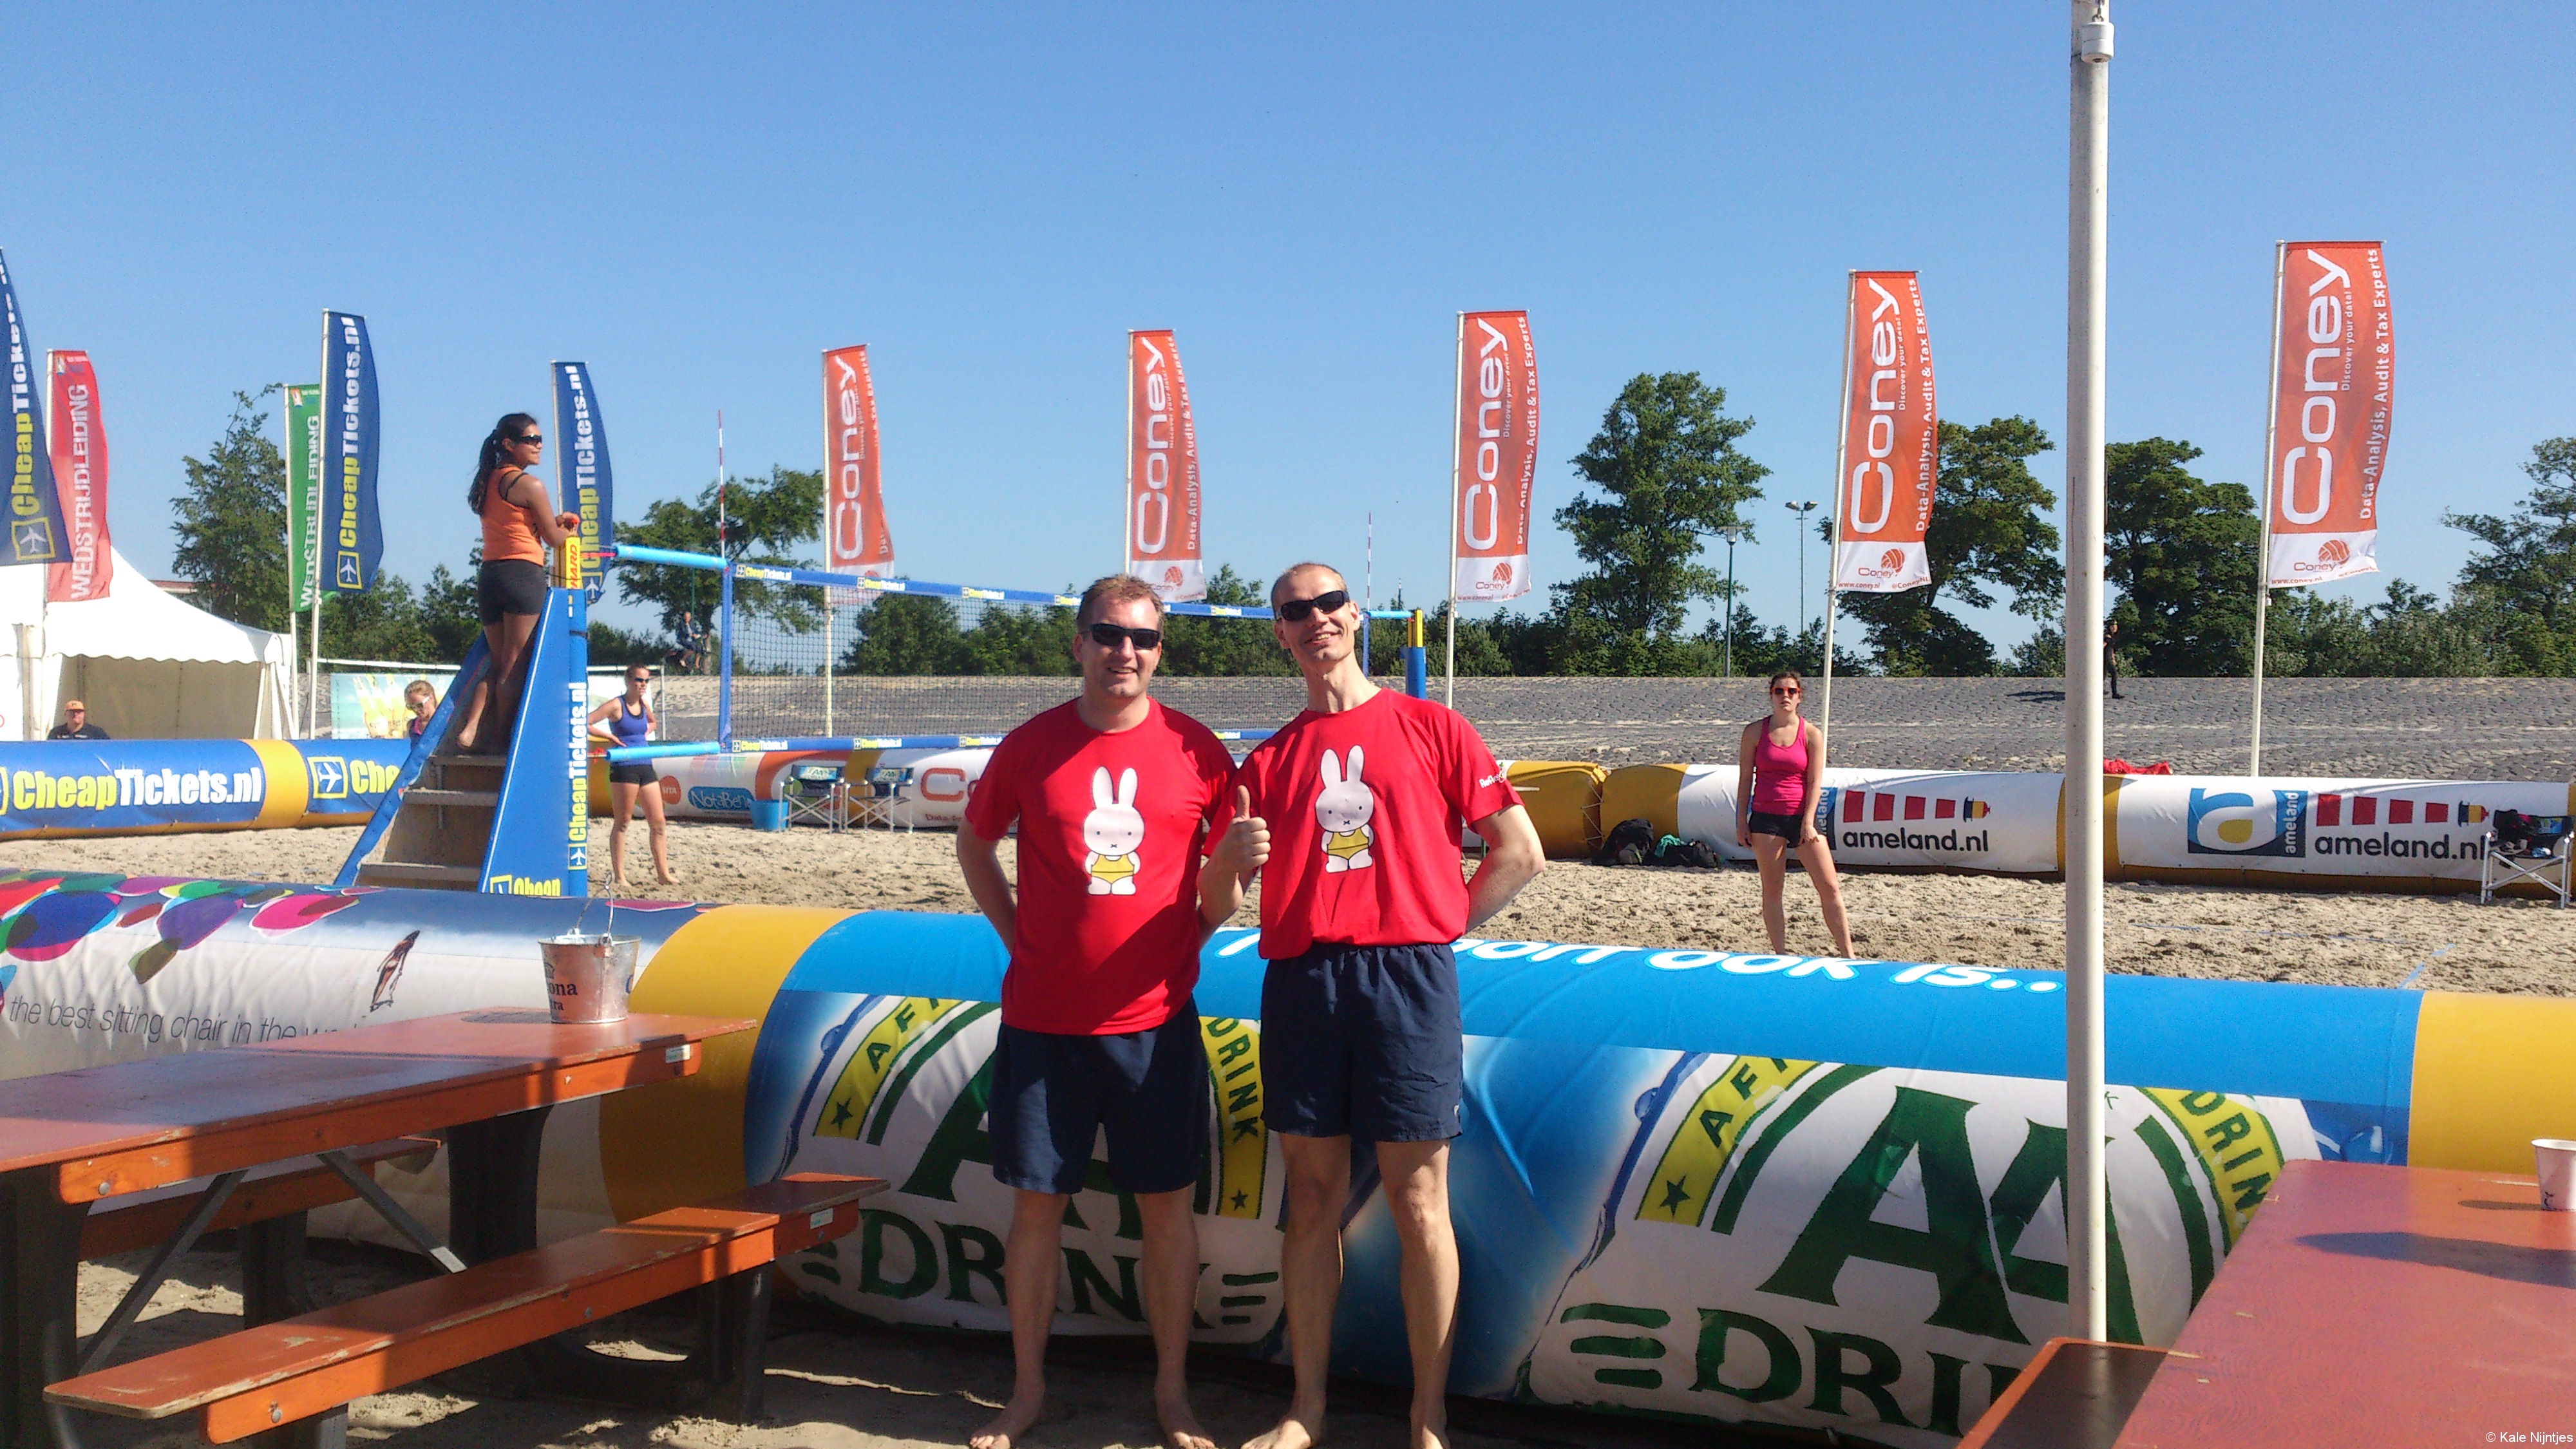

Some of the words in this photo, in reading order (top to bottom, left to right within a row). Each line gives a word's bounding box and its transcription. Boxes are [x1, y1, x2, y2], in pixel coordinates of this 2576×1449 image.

[2367, 249, 2387, 308] Experts
[1908, 279, 1926, 334] Experts
[2344, 291, 2353, 317] data!
[2376, 312, 2389, 339] Tax
[1517, 316, 1534, 367] Experts
[1920, 338, 1929, 363] Tax
[2345, 321, 2355, 344] your
[2376, 343, 2389, 355] &
[1897, 344, 1906, 367] your
[1922, 366, 1931, 377] &
[2341, 347, 2353, 391] Discover
[1526, 370, 1537, 394] Tax
[1527, 397, 1537, 406] &
[1922, 381, 1933, 422] Audit
[2282, 249, 2351, 524] Coney
[2373, 358, 2389, 402] Audit
[1502, 401, 1512, 438] Discover
[1526, 409, 1537, 446] Audit
[1850, 278, 1900, 533] Coney
[338, 317, 361, 547] CheapTickets.nl
[1138, 337, 1170, 554] Coney
[1464, 317, 1508, 551] Coney
[565, 365, 600, 569] CheapTickets.nl
[835, 354, 863, 559] Coney
[1916, 426, 1934, 531] Data-Analysis,
[2360, 407, 2388, 519] Data-Analysis,
[68, 384, 95, 600] WEDSTRIJDLEIDING
[1517, 450, 1535, 545] Data-Analysis,
[1475, 582, 1505, 591] Coney
[1858, 567, 1893, 578] Coney
[2294, 562, 2336, 572] Coney
[569, 682, 587, 841] CheapTickets.nl
[13, 766, 261, 811] CheapTickets.nl
[1842, 827, 1989, 852] ameland.nl
[2284, 791, 2298, 855] ameland
[2315, 831, 2486, 860] ameland.nl
[10, 995, 42, 1024] the
[48, 998, 96, 1029] best
[100, 1003, 164, 1043] sitting
[171, 1010, 227, 1041] chair
[232, 1014, 252, 1045] in
[260, 1017, 297, 1042] the
[1206, 1018, 1259, 1141] DRINK
